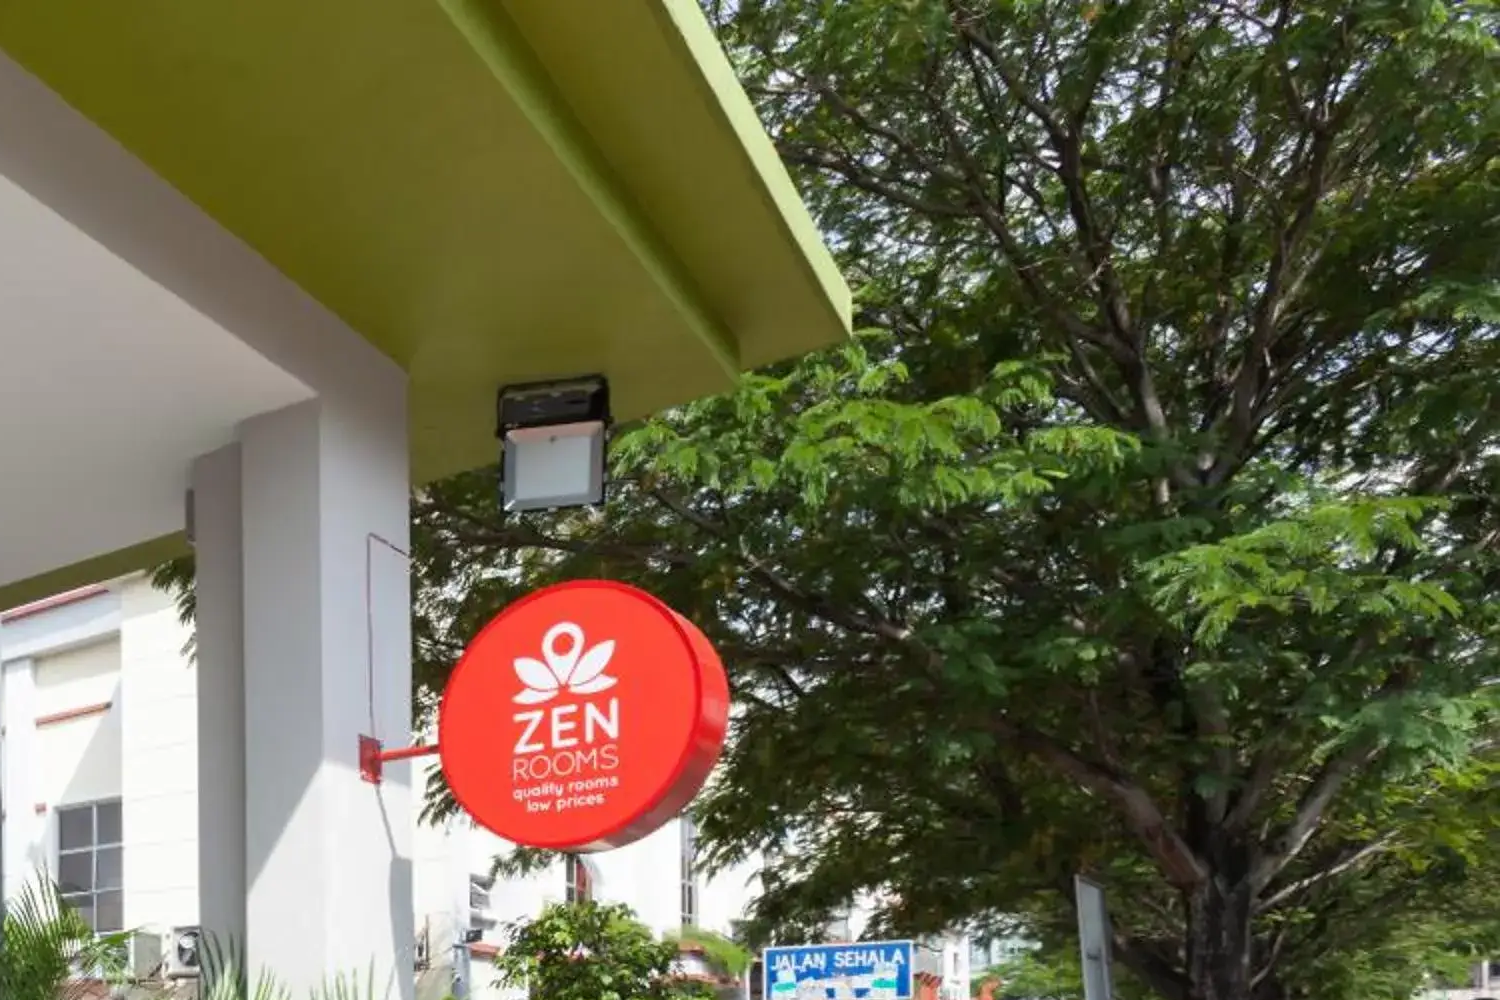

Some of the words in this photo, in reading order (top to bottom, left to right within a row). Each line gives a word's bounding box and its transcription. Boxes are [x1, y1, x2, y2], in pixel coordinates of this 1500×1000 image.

[512, 697, 619, 755] ZEN
[512, 743, 620, 782] ROOMS
[512, 782, 564, 802] quality
[567, 775, 619, 794] rooms
[526, 800, 551, 813] low
[556, 793, 605, 813] prices
[770, 951, 827, 971] JALAN
[834, 948, 905, 967] SEHALA
